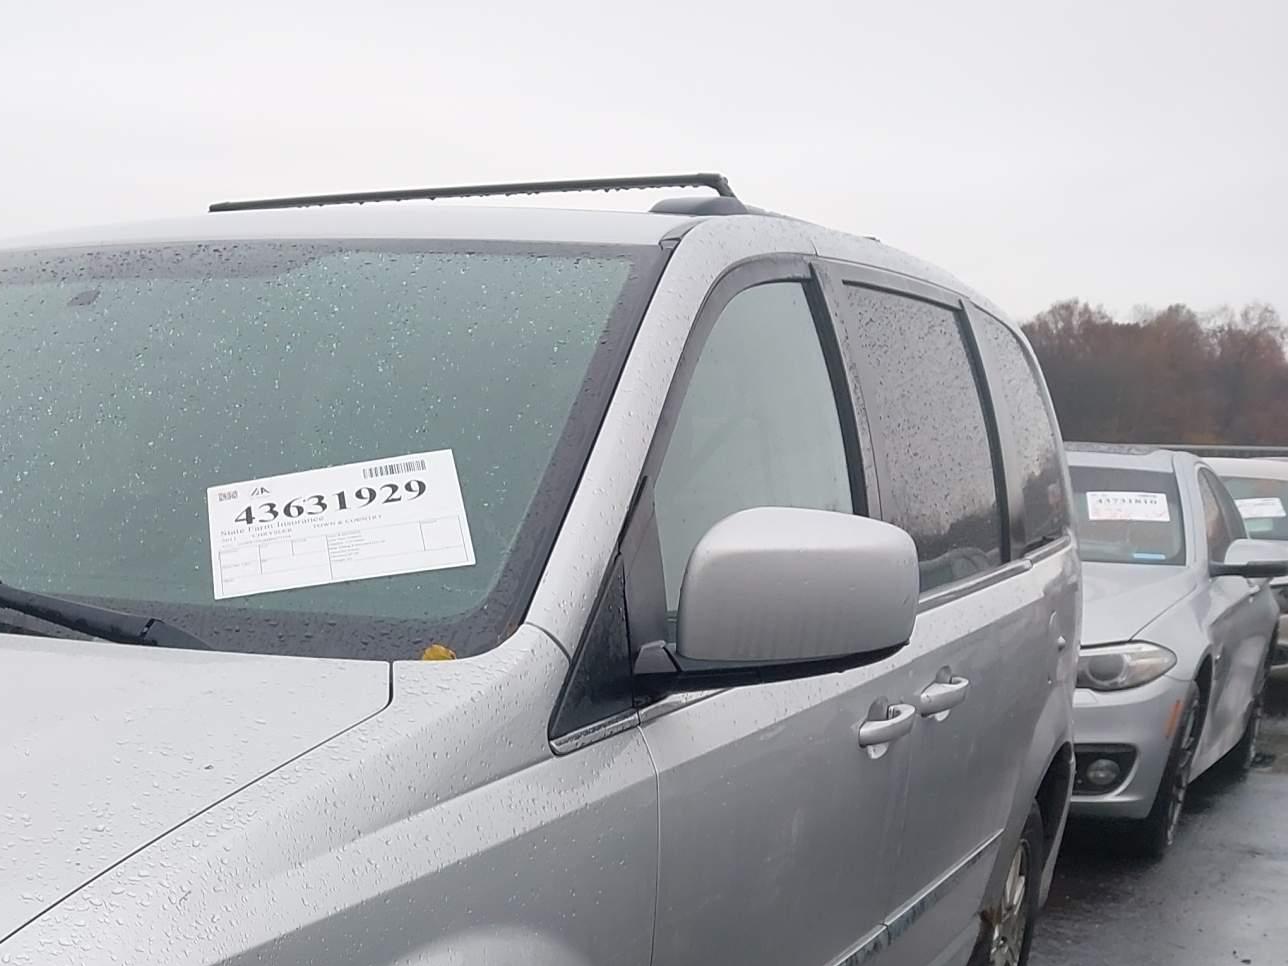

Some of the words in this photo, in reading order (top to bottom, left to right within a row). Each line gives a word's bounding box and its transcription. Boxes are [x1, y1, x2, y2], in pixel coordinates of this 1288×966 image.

[234, 479, 426, 525] 43631929
[248, 523, 273, 533] Farm
[277, 516, 324, 528] Insurance
